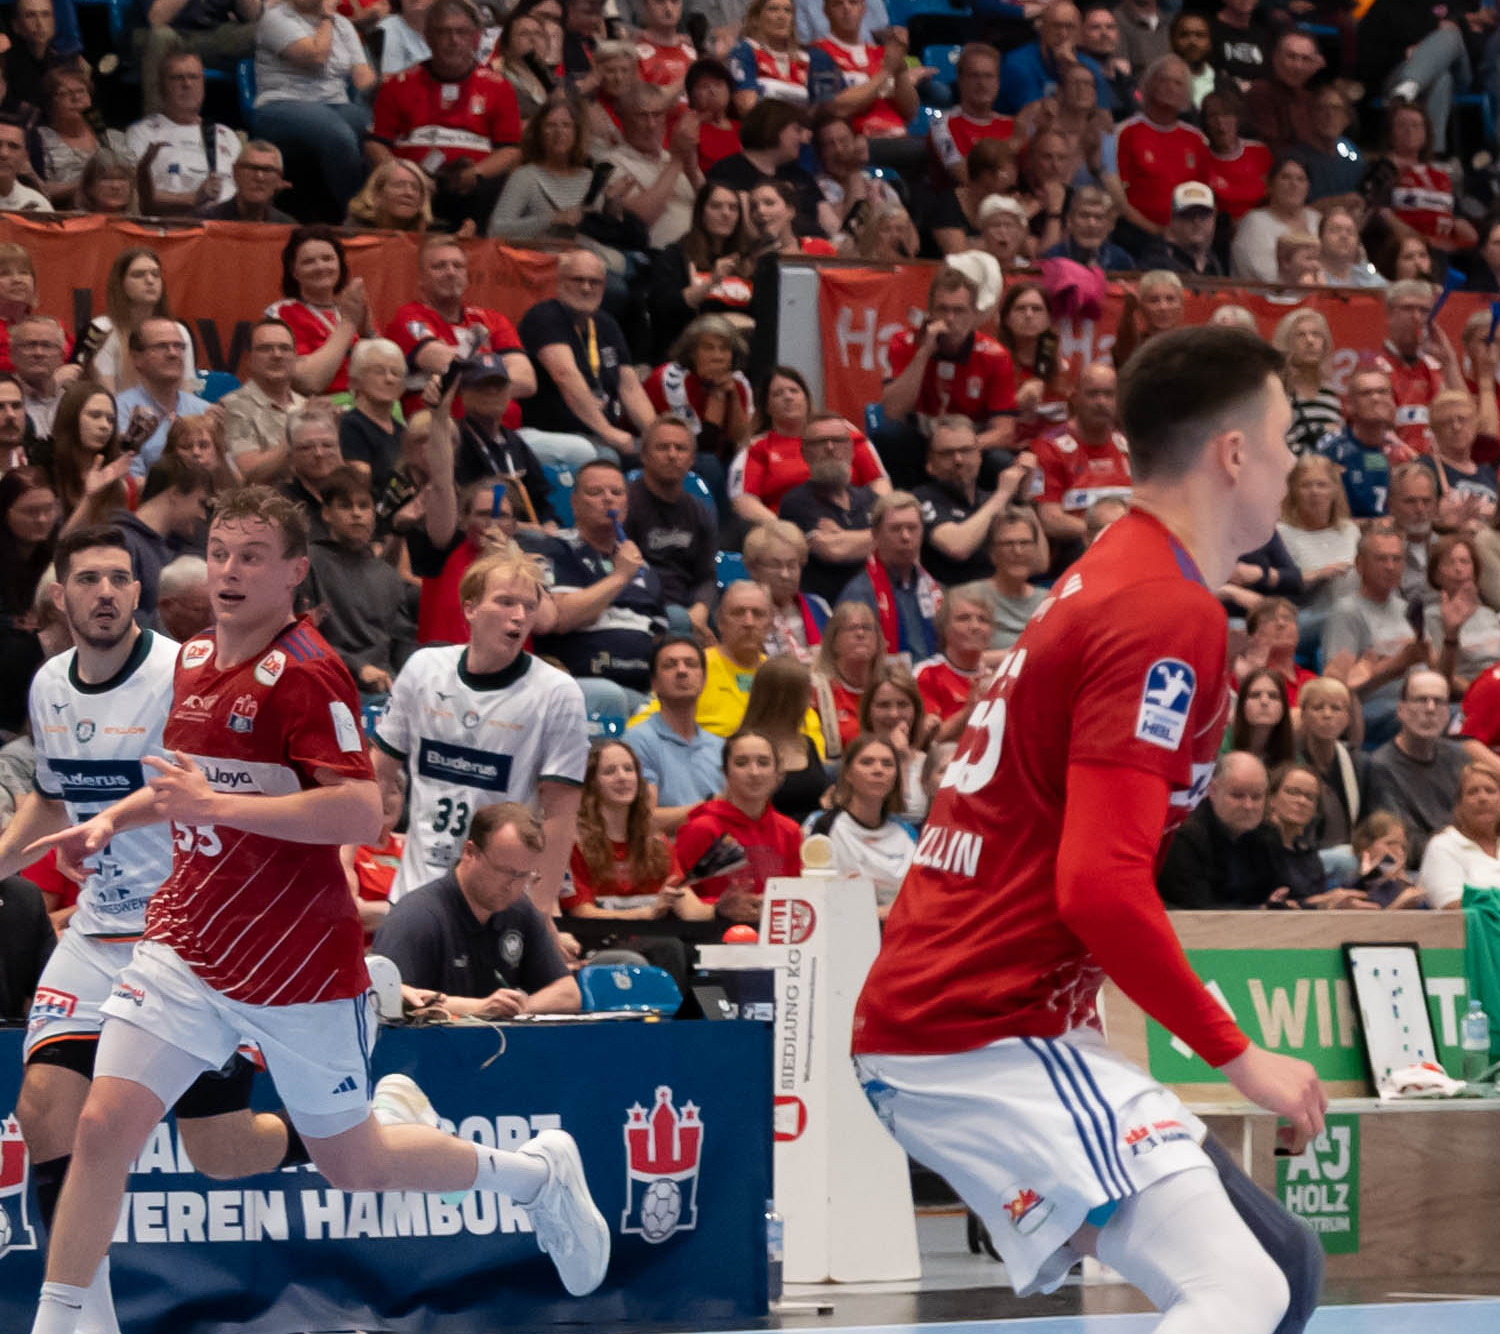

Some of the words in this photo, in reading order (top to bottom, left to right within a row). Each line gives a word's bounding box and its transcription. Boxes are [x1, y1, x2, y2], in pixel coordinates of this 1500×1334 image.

[426, 750, 499, 777] Buderus
[432, 797, 470, 838] 33
[301, 1188, 533, 1243] HAMBUR
[1285, 1183, 1350, 1214] HOLZ
